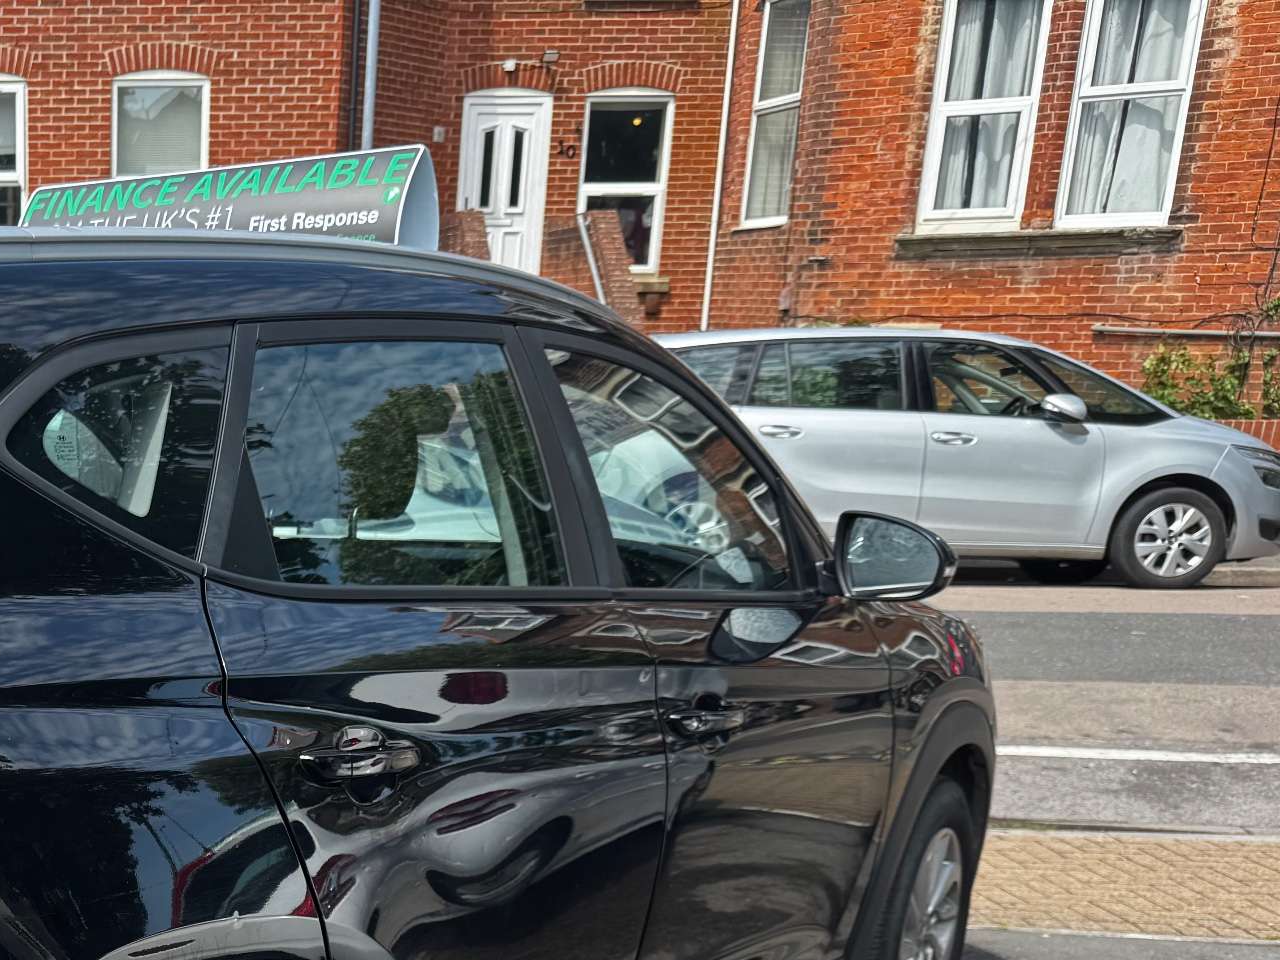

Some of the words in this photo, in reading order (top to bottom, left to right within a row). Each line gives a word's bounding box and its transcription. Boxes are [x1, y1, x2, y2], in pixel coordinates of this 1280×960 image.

[25, 176, 186, 222] FINANCE
[183, 152, 416, 203] AVAILABLE
[205, 203, 234, 231] #1
[248, 214, 288, 233] First
[292, 209, 380, 231] Response
